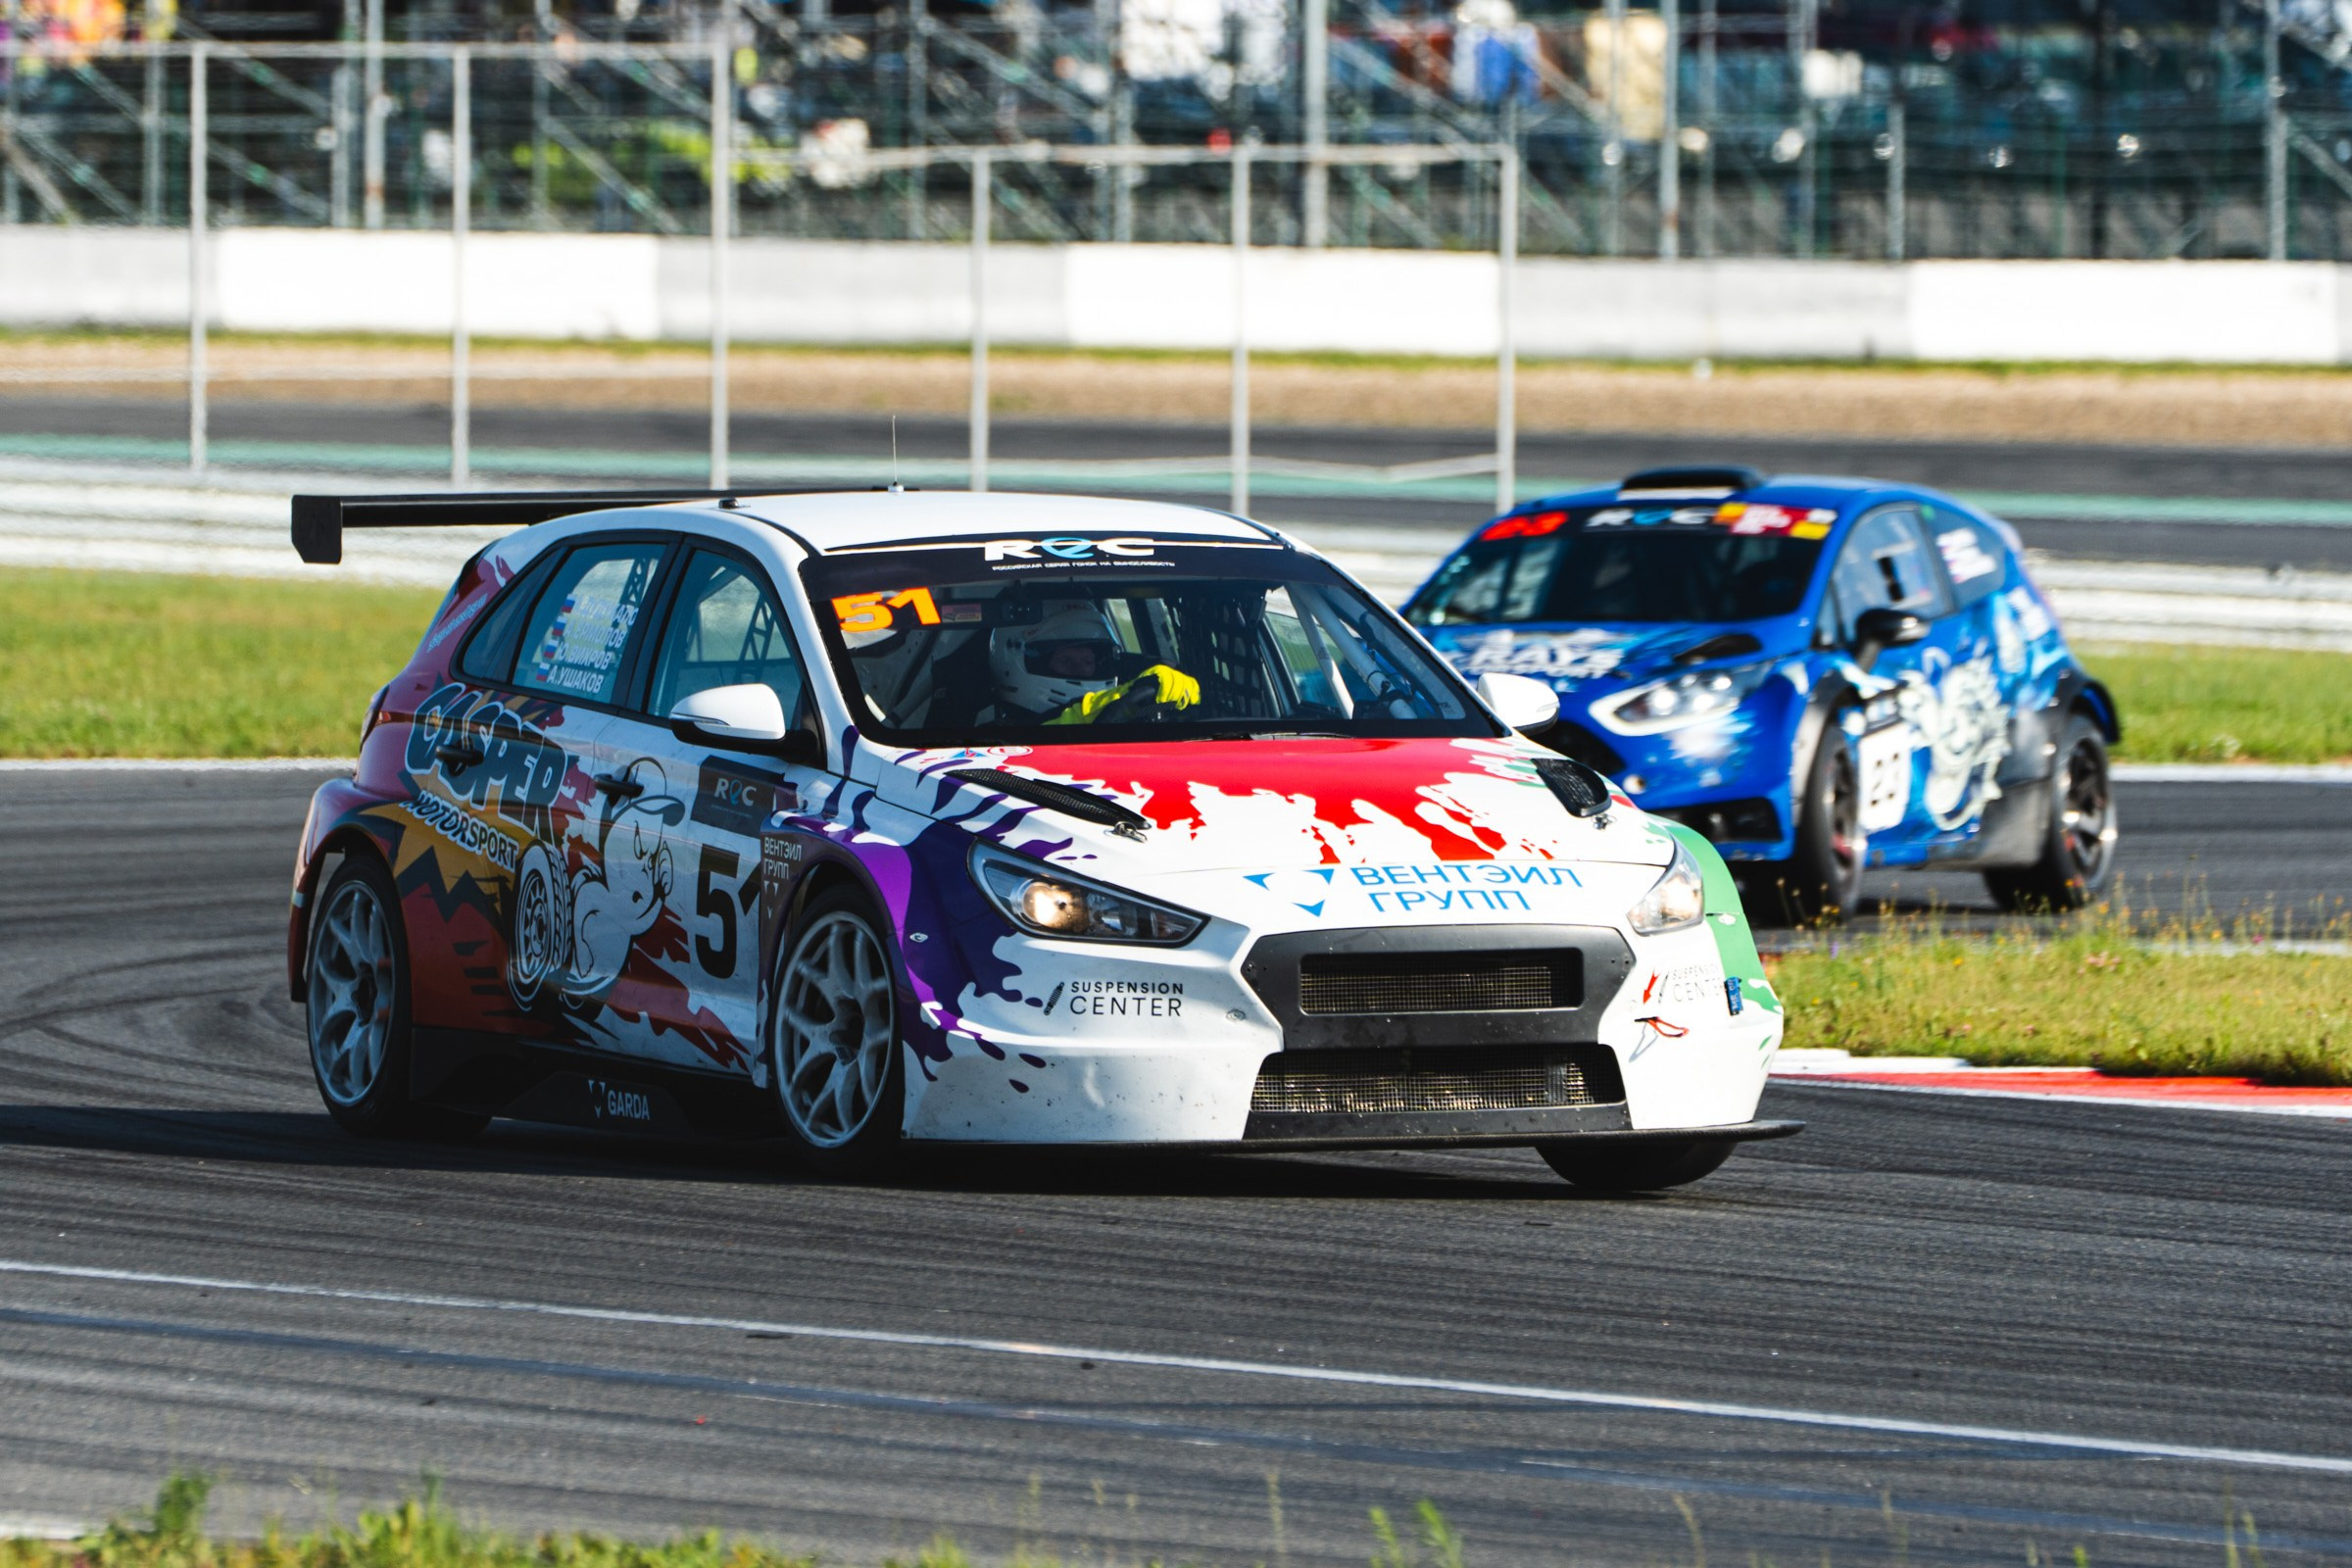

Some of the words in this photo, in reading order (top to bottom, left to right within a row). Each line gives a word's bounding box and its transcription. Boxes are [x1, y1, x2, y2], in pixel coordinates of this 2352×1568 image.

[832, 586, 941, 633] 51
[547, 664, 605, 694] А.УШАКОВ
[405, 682, 568, 849] CASPER
[399, 790, 519, 873] MOTORSPORT
[763, 837, 802, 862] ВЕНТЭИЛ
[763, 858, 790, 881] ГРУПП
[1349, 864, 1584, 888] ВЕНТЭИЛ
[1368, 890, 1532, 912] ГРУПП
[1070, 981, 1184, 995] SUSPENSION
[1069, 996, 1182, 1017] CENTER
[608, 1089, 651, 1121] GARDA
